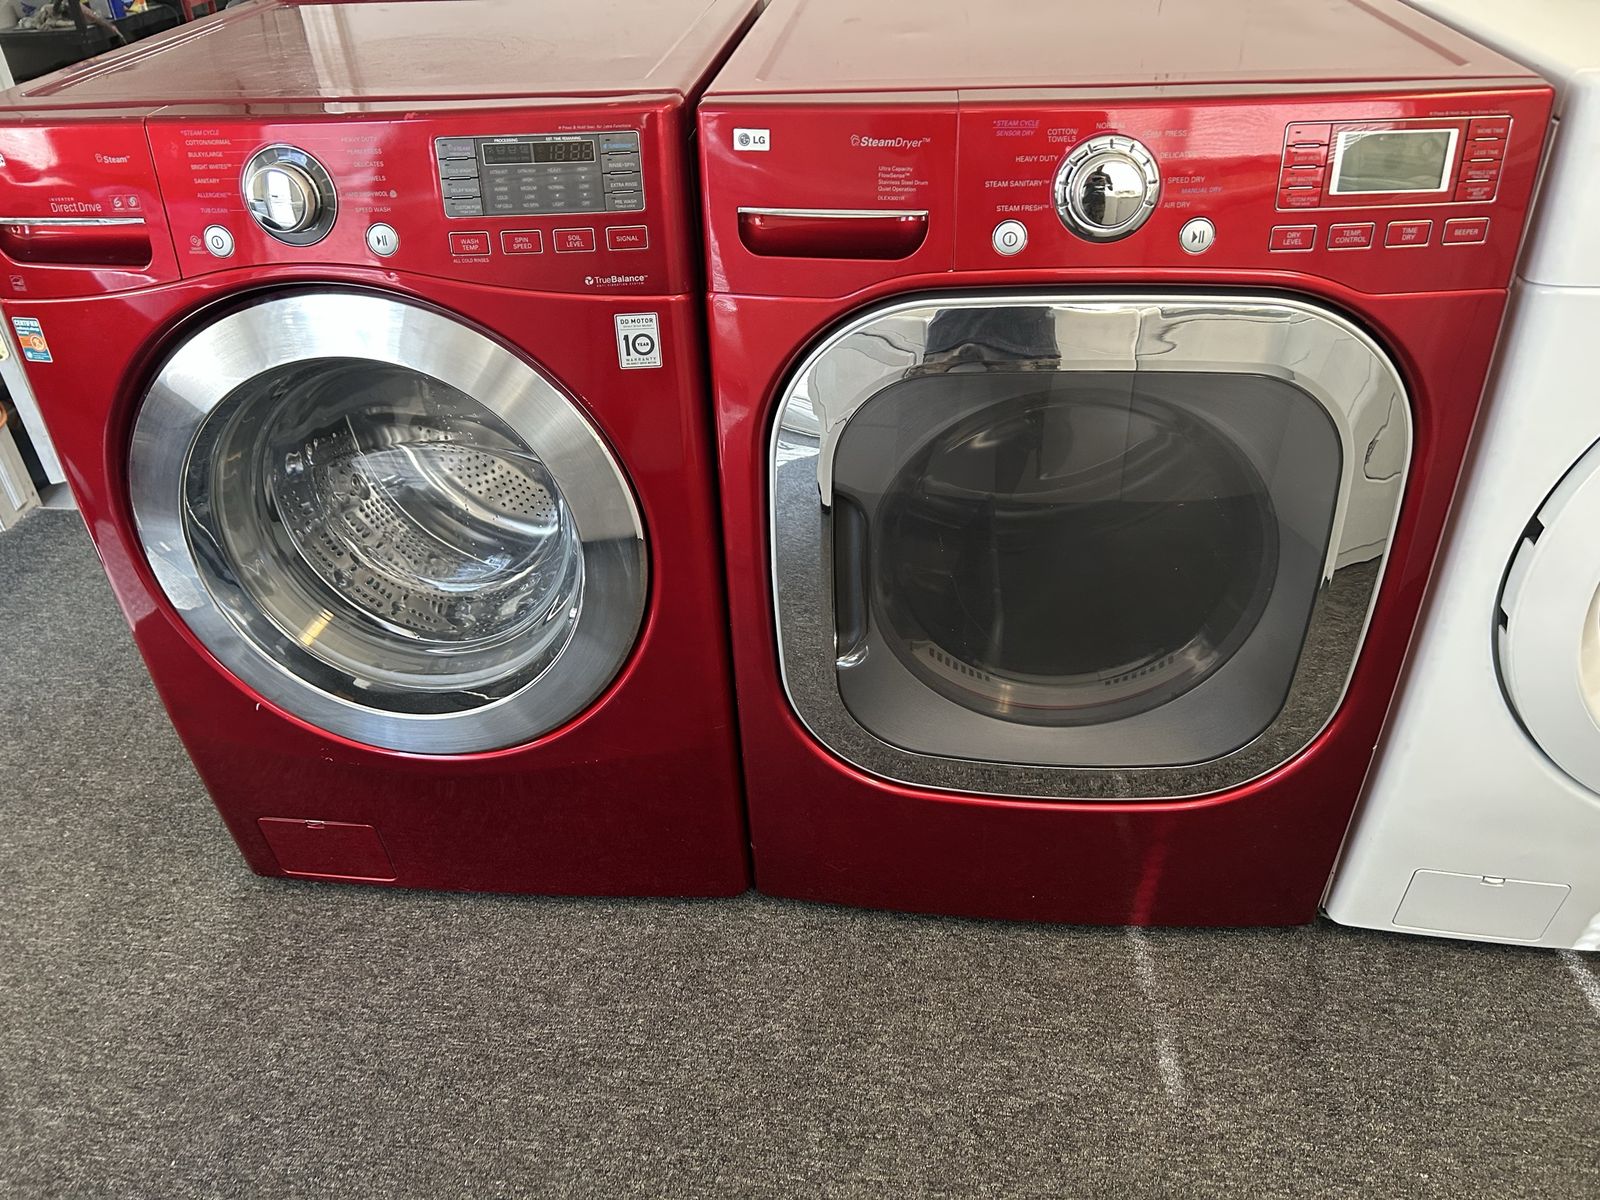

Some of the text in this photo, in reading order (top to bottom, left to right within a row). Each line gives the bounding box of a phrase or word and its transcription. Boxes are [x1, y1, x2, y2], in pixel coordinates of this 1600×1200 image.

[753, 136, 765, 145] LG
[50, 202, 102, 212] Direct Drive
[623, 333, 655, 356] 10
